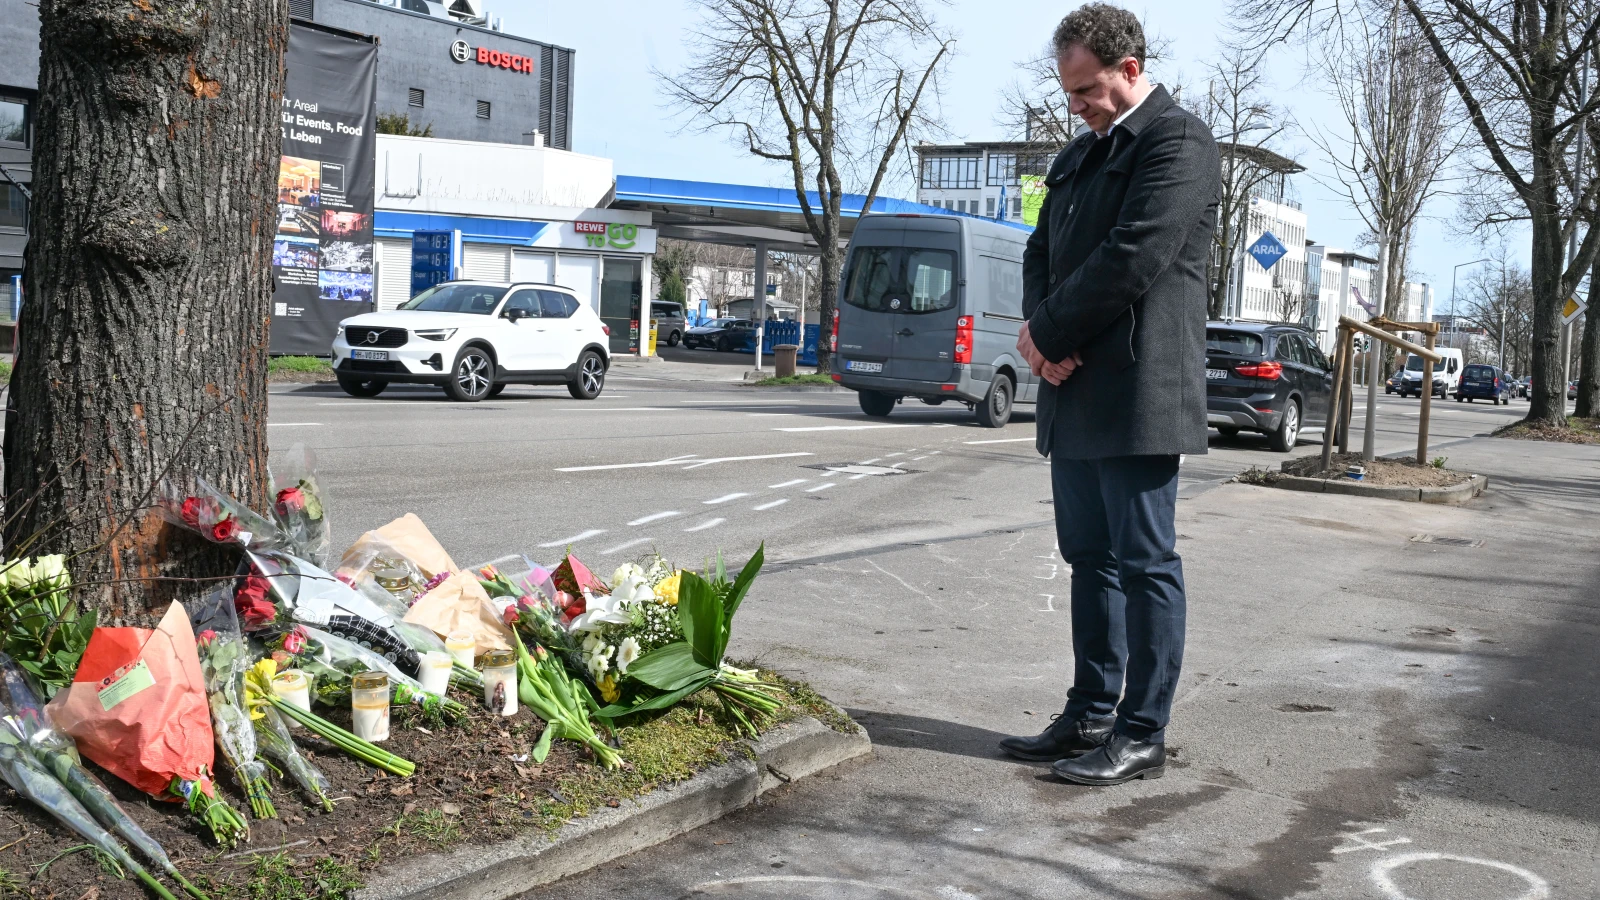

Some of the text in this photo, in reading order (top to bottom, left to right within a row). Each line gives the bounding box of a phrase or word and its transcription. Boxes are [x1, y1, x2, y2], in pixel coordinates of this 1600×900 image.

[477, 46, 534, 73] BOSCH
[282, 96, 318, 113] hr Areal
[296, 114, 334, 133] Events,
[336, 121, 363, 137] Food
[290, 128, 322, 145] Leben
[576, 222, 604, 232] REWE
[585, 222, 637, 247] TO GO
[1252, 244, 1282, 255] ARAL
[1209, 369, 1227, 378] 2717
